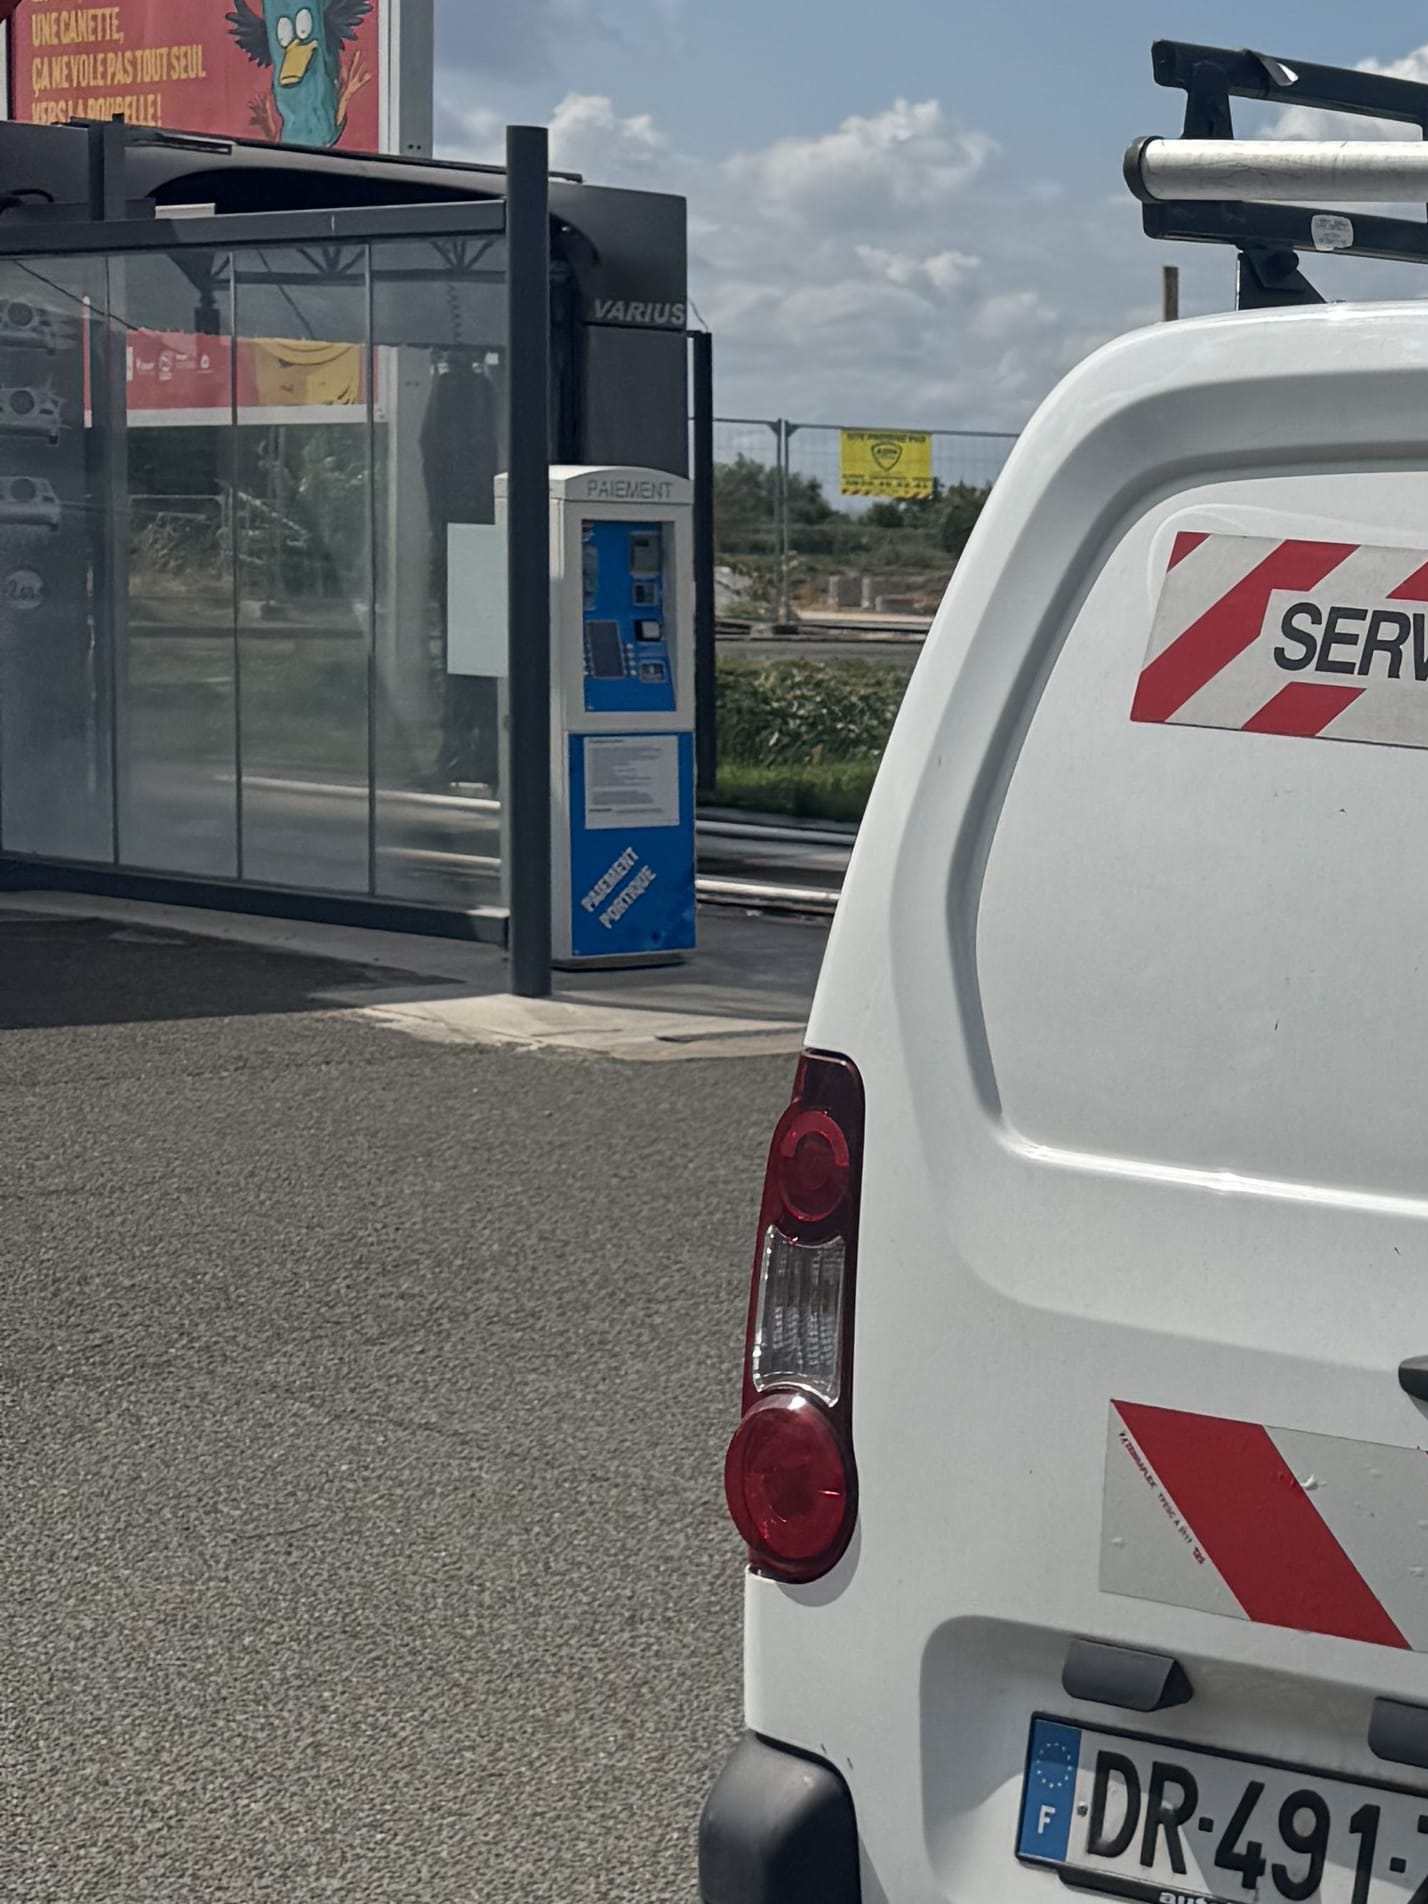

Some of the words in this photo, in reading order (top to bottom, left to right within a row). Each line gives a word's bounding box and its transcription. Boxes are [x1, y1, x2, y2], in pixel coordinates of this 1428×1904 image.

[32, 12, 58, 47] UNE
[60, 7, 124, 45] CANETTE,
[32, 57, 50, 97] ÇA
[51, 56, 69, 89] NE
[70, 53, 104, 88] VOLE
[106, 51, 133, 85] PAS
[135, 47, 168, 84] TOUT
[169, 44, 206, 81] SEUL
[32, 99, 66, 126] VERS
[594, 298, 685, 325] VARIUS
[587, 479, 673, 500] PAIEMENT
[581, 846, 639, 913] PAIEMENT
[599, 864, 657, 929] PORTIQUE
[1036, 1804, 1056, 1835] F
